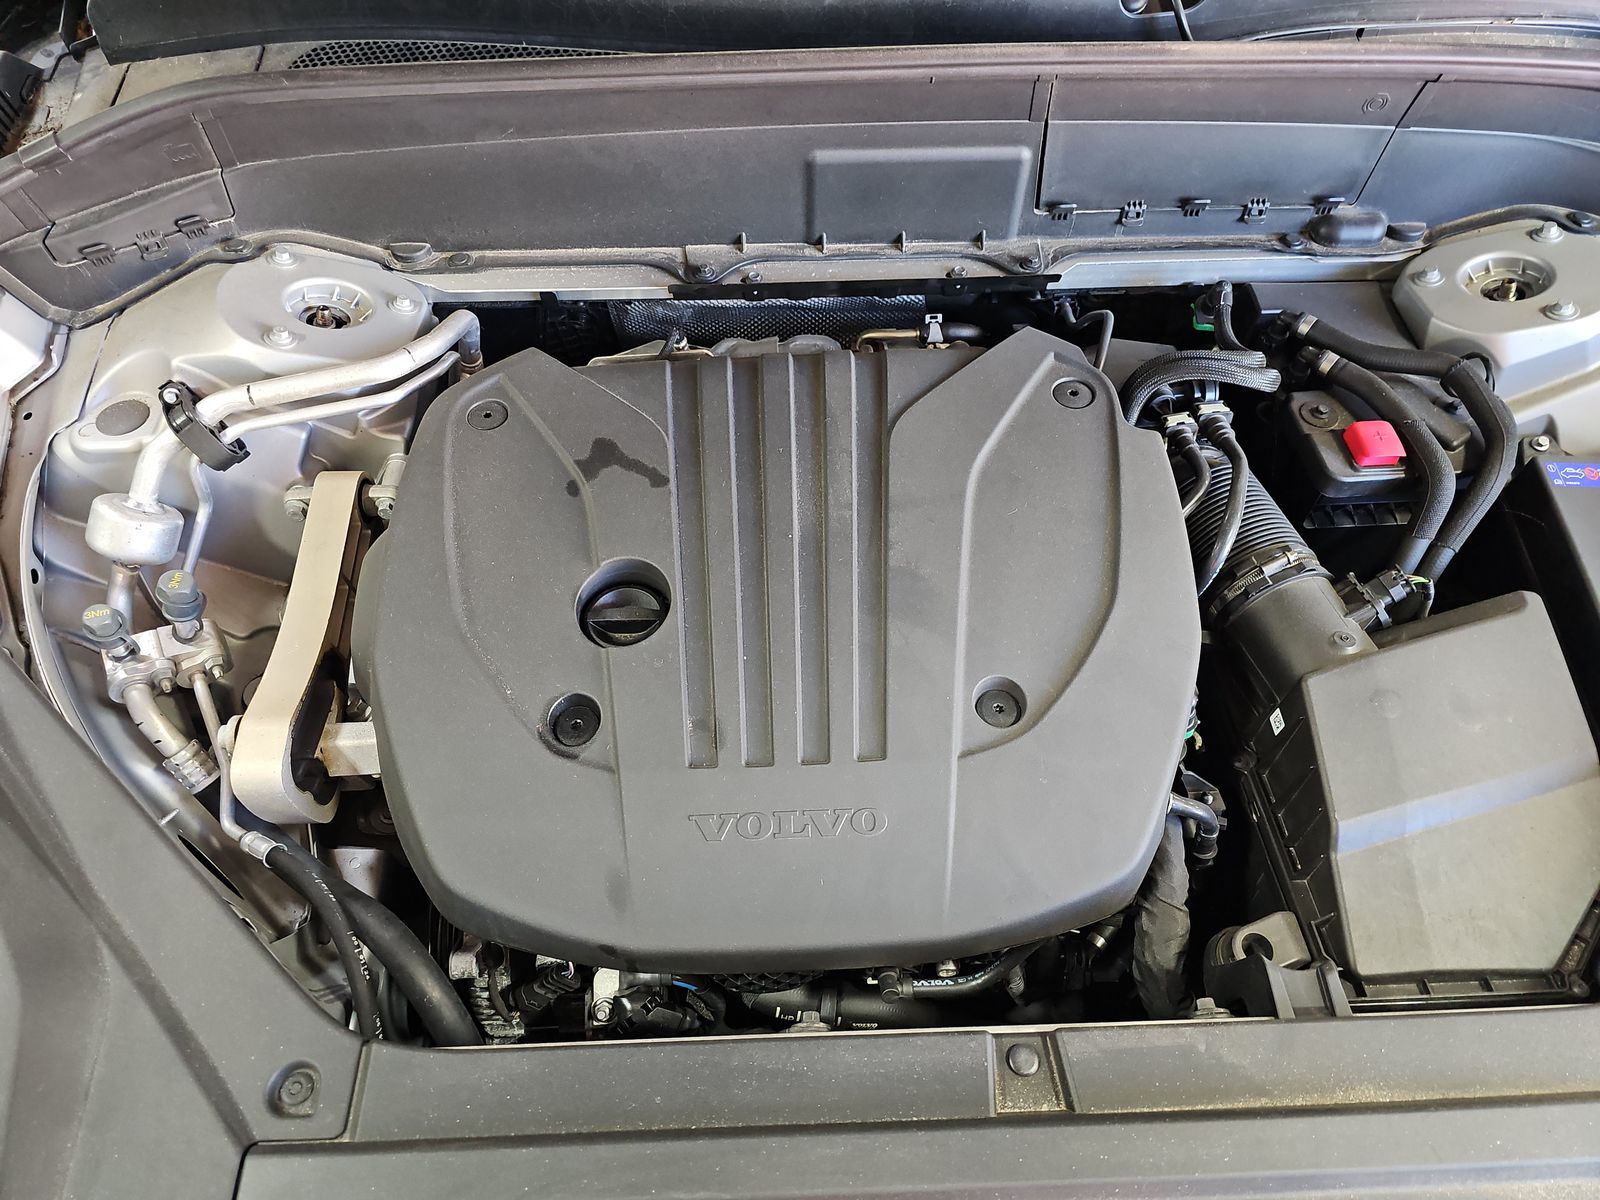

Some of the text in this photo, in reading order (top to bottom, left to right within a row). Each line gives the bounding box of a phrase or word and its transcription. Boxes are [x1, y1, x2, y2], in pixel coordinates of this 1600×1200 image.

[169, 572, 183, 589] 3Nm
[84, 608, 110, 620] 3Nm
[688, 807, 888, 842] VOLVO
